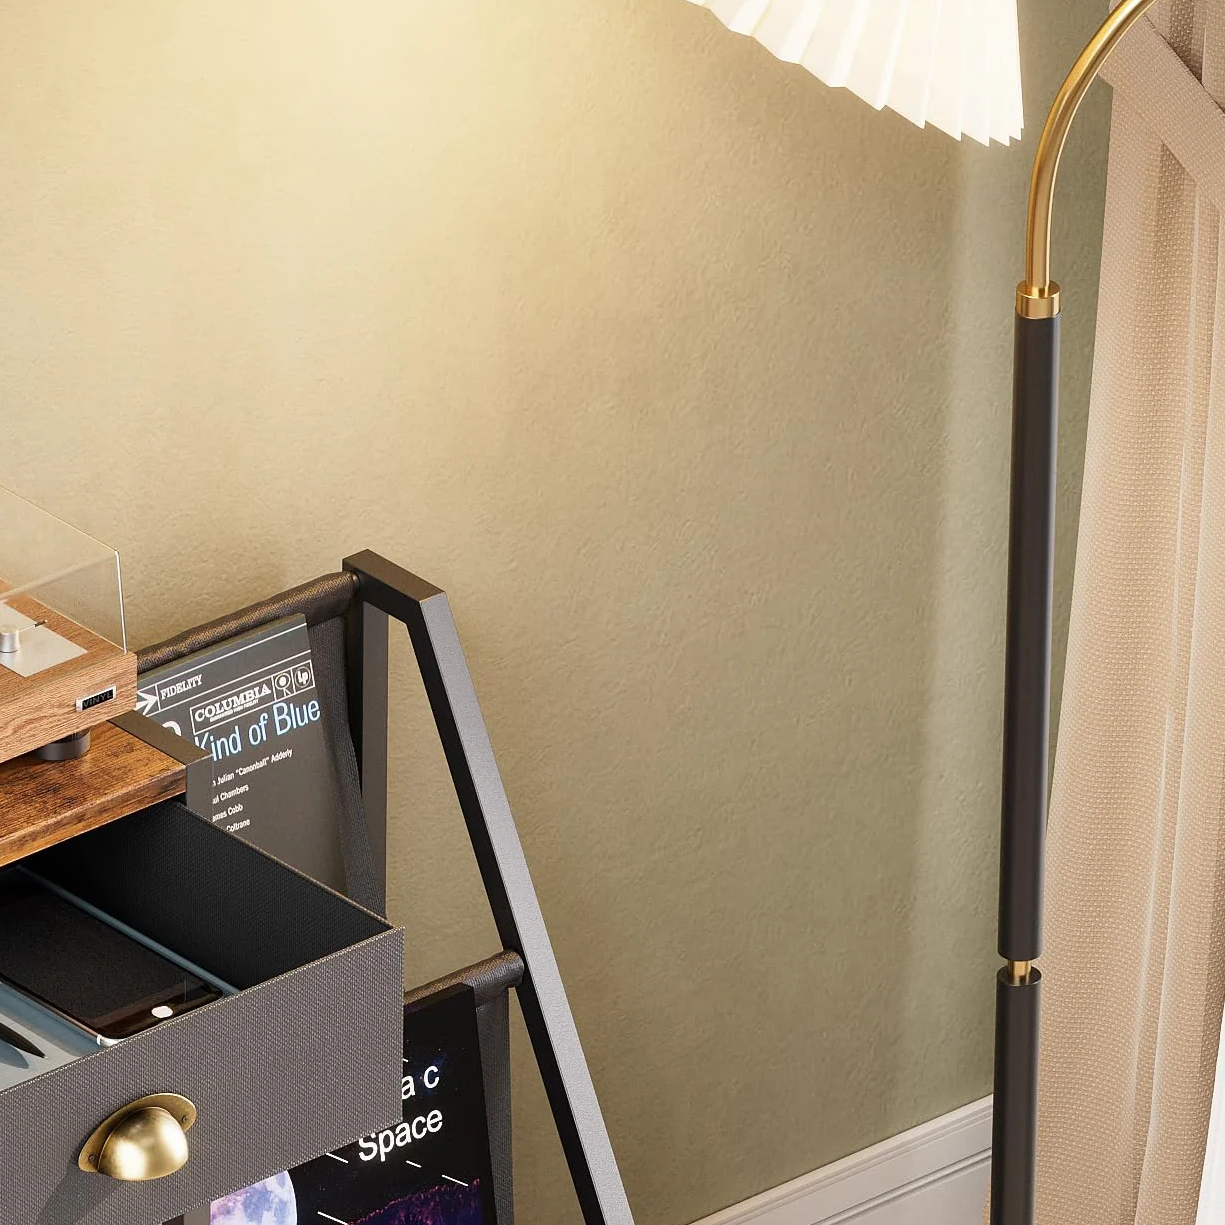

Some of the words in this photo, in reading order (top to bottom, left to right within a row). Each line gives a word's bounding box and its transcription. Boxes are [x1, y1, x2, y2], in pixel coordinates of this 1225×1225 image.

[160, 674, 203, 700] FIDELITY
[83, 691, 113, 707] VINYL
[194, 684, 272, 722] COLUMBIA
[248, 713, 269, 745] of
[273, 700, 321, 736] Blue
[217, 772, 235, 785] Julian
[220, 784, 249, 801] Chambers
[213, 810, 227, 822] ames
[228, 804, 243, 816] Cobb
[359, 1109, 443, 1162] Space
